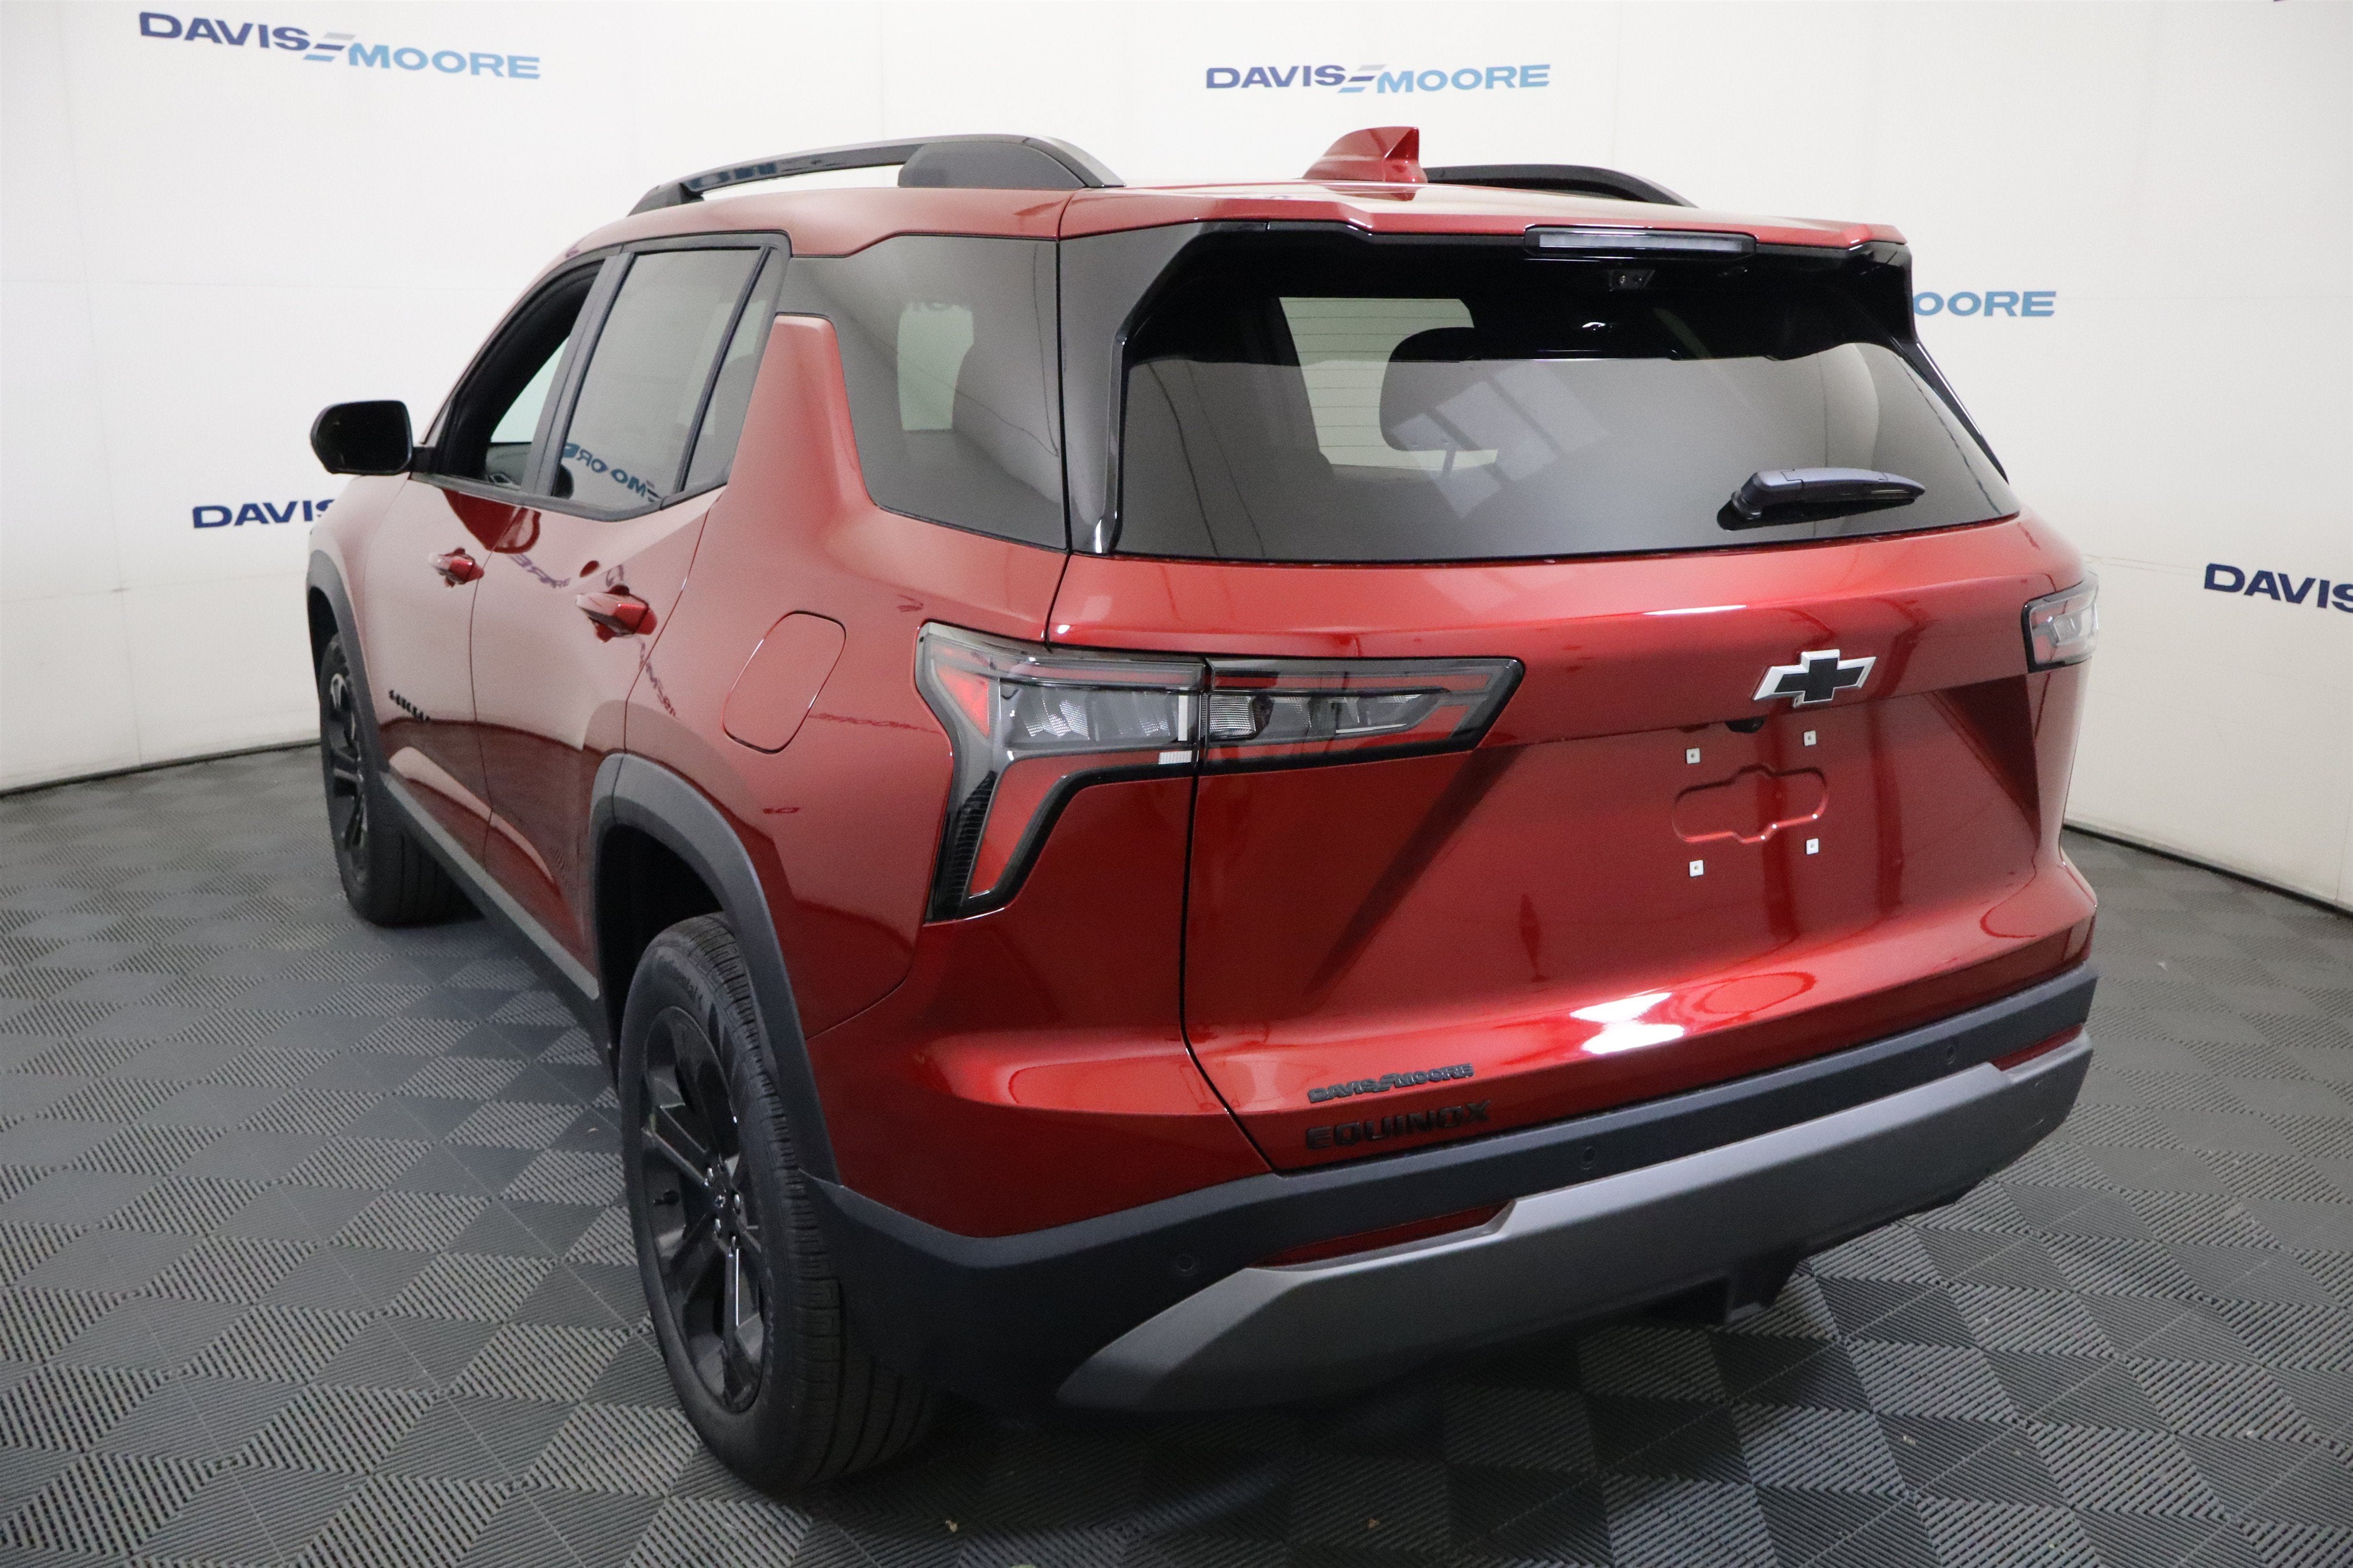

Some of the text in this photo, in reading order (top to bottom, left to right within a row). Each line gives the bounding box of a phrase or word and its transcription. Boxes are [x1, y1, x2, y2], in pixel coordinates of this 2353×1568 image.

[139, 11, 541, 79] DAVIS MOORE
[1206, 64, 1550, 94] DAVIS MOORE
[1394, 1063, 1475, 1088] MOORE
[1305, 1099, 1491, 1150] EQUINOX
